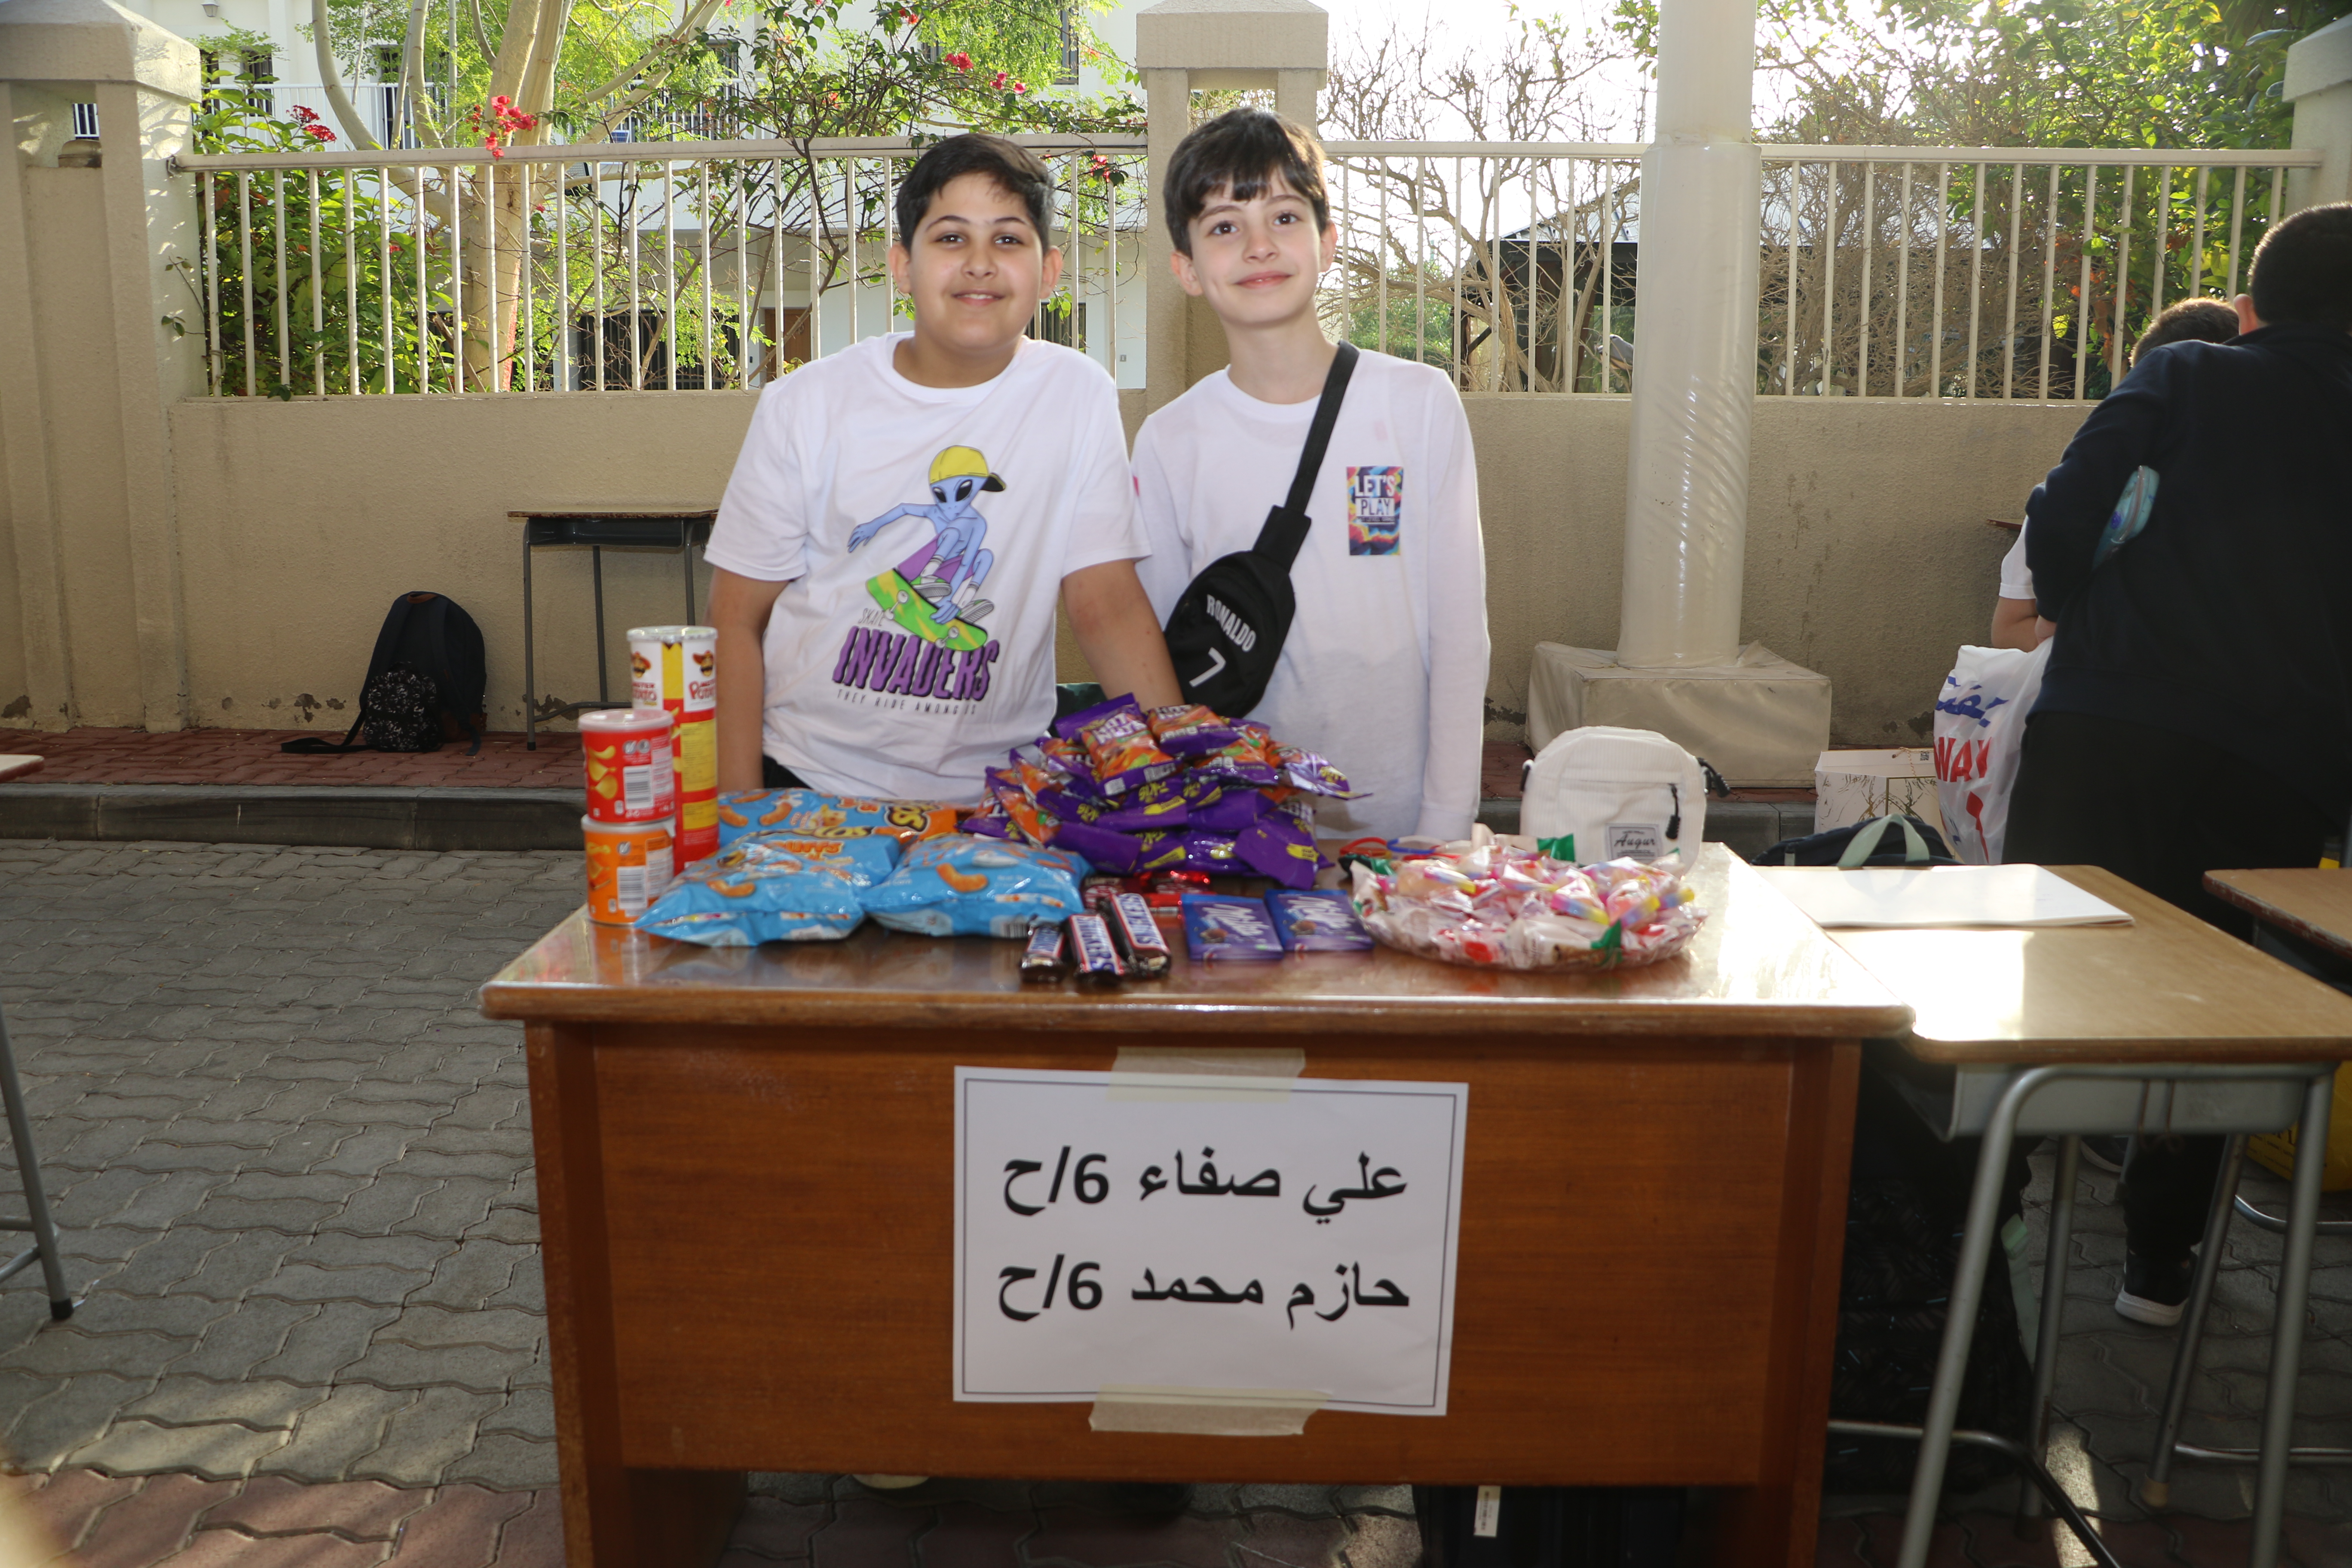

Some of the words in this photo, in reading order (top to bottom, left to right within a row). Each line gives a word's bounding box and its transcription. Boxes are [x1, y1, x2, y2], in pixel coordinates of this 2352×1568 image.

[1354, 475, 1395, 496] LET'S
[1361, 499, 1390, 515] PLAY
[858, 607, 885, 626] SKATE
[1207, 594, 1256, 652] RONALDO
[832, 625, 1000, 701] INVADERS
[1189, 647, 1226, 688] 7
[837, 689, 866, 704] THEY
[875, 697, 905, 710] RIDE
[915, 701, 959, 715] AMONG
[1614, 834, 1655, 849] Augur
[1005, 1147, 1109, 1216] 6/ح
[1140, 1147, 1280, 1200] صفاء
[1303, 1153, 1406, 1224] علي
[1000, 1255, 1102, 1321] 6/ح
[1132, 1269, 1263, 1304] محمد
[1287, 1263, 1409, 1329] حازم
